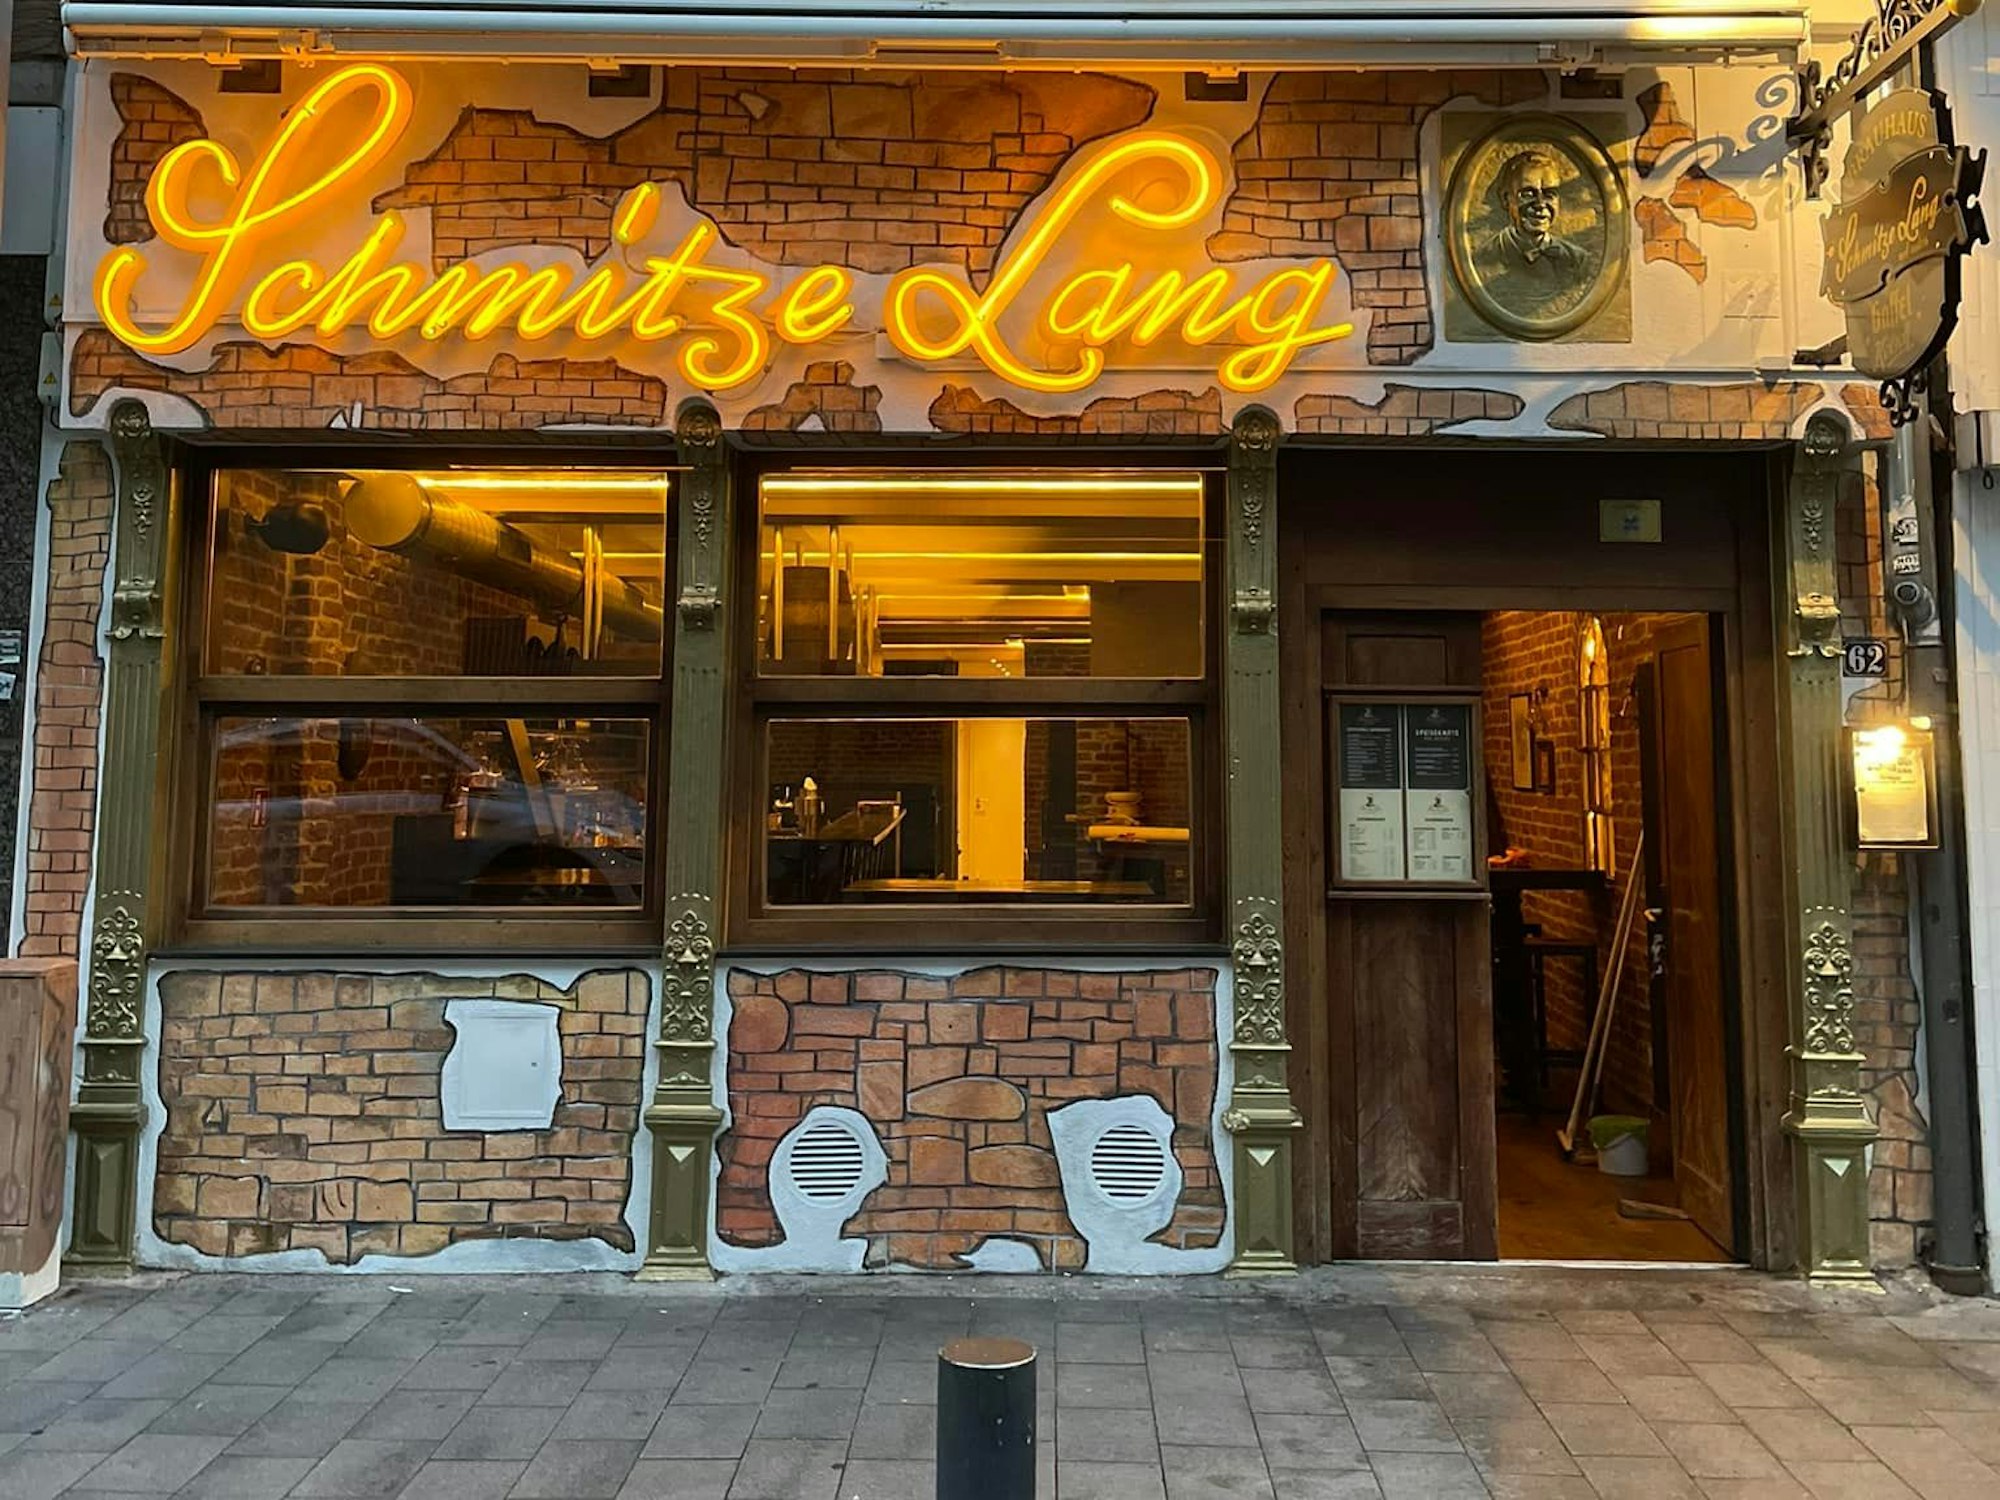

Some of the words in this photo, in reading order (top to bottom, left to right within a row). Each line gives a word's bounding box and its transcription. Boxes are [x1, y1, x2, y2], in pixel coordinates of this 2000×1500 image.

[97, 62, 853, 389] Schmitze
[888, 134, 1353, 391] Lang
[1836, 211, 1896, 282] Schmitze
[1897, 175, 1941, 242] Lang
[1848, 644, 1883, 673] 62
